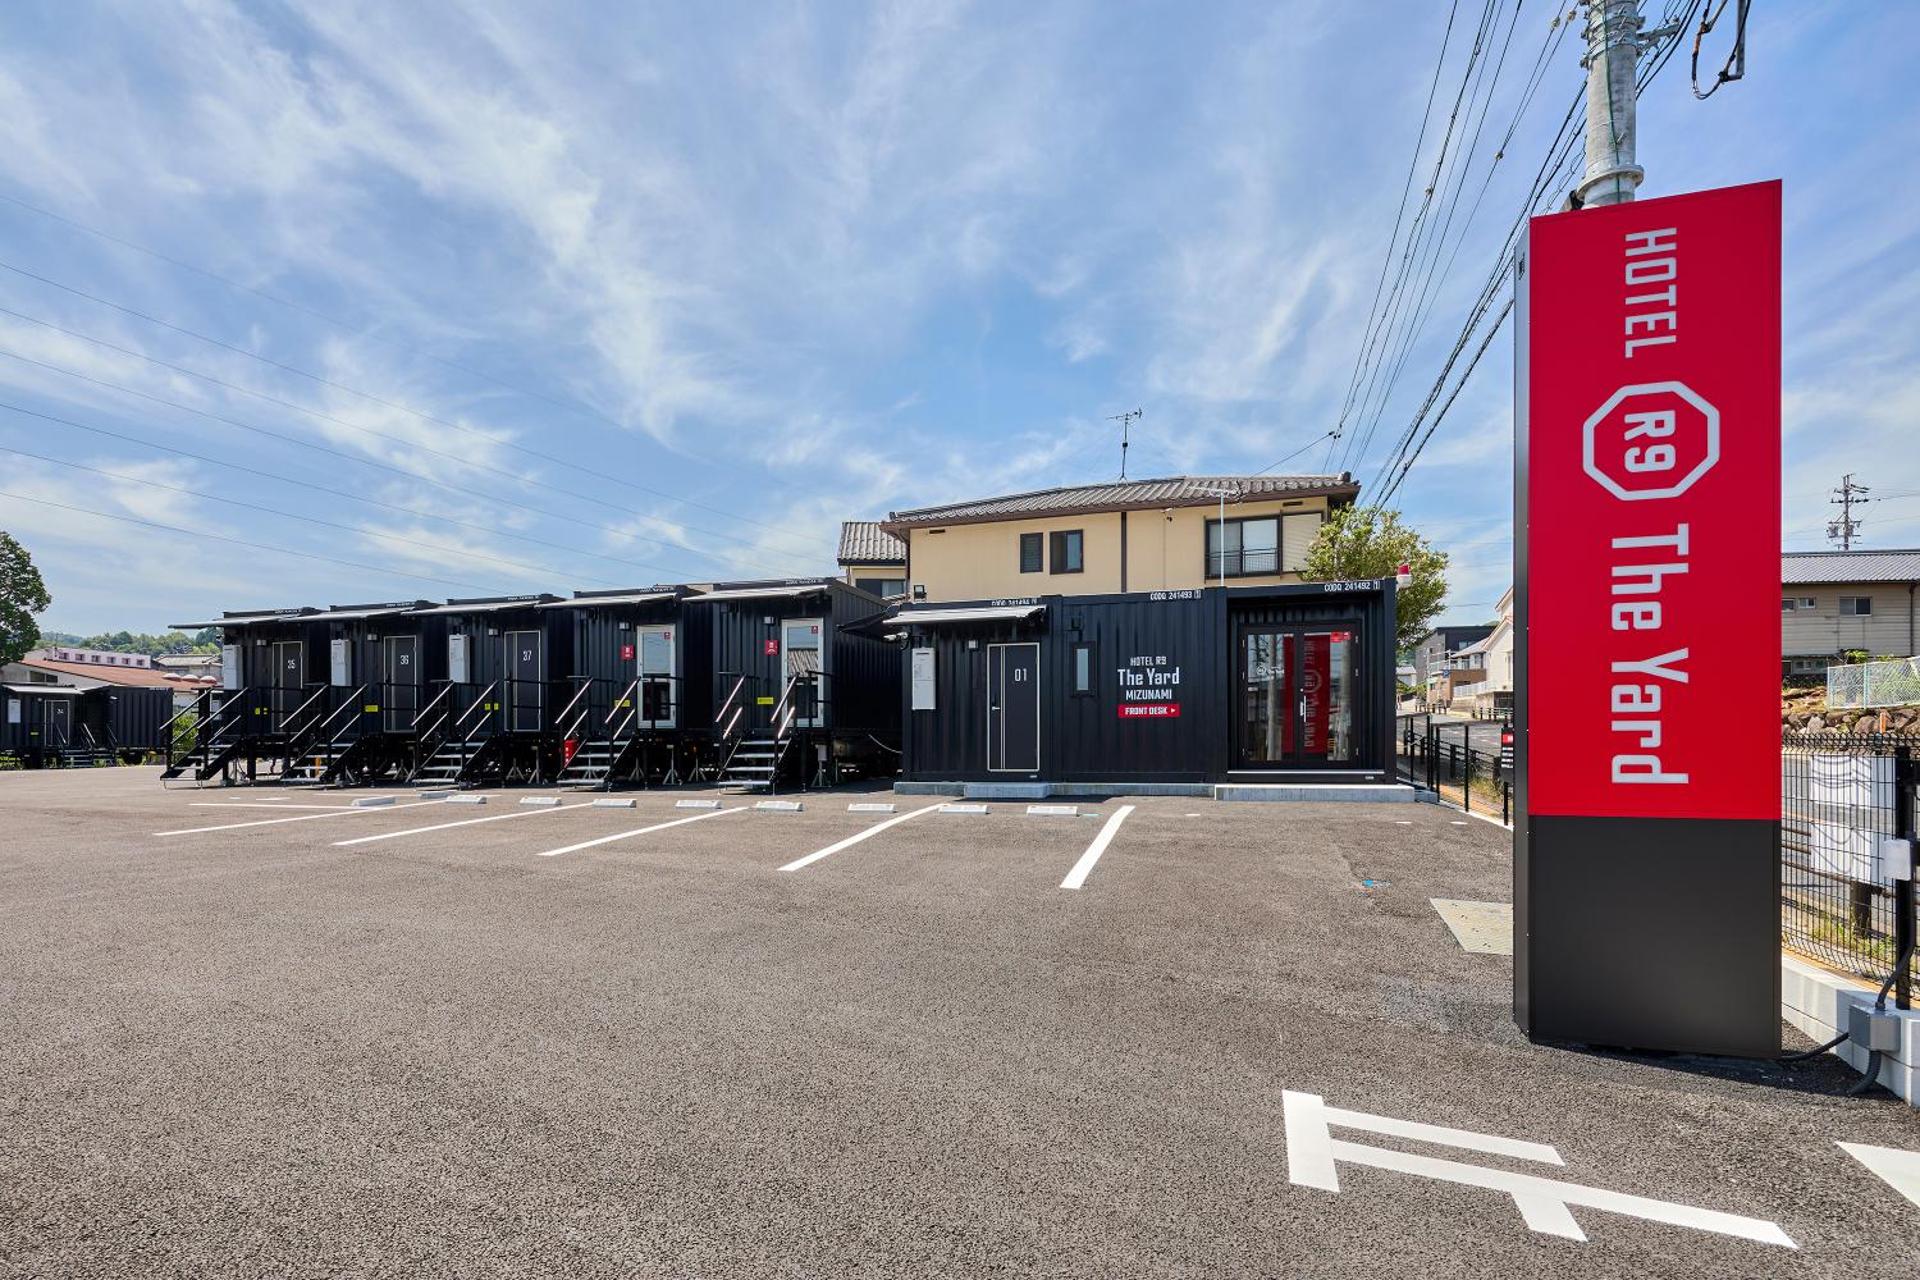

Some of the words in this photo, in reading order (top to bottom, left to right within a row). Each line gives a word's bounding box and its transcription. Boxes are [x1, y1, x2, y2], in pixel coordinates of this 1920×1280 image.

[1624, 227, 1677, 358] HOTEL
[1624, 410, 1676, 474] R9
[1612, 523, 1689, 631] The
[400, 655, 409, 665] 36
[523, 650, 532, 661] 37
[1130, 656, 1154, 667] HOTEL
[1155, 656, 1167, 665] R9
[1014, 668, 1027, 682] 01
[1117, 668, 1144, 686] The
[1146, 666, 1180, 686] Yard
[1125, 688, 1172, 701] MIZUNAMI
[1124, 707, 1147, 715] FRONT
[1148, 706, 1168, 715] DESK
[1612, 647, 1689, 785] Yard
